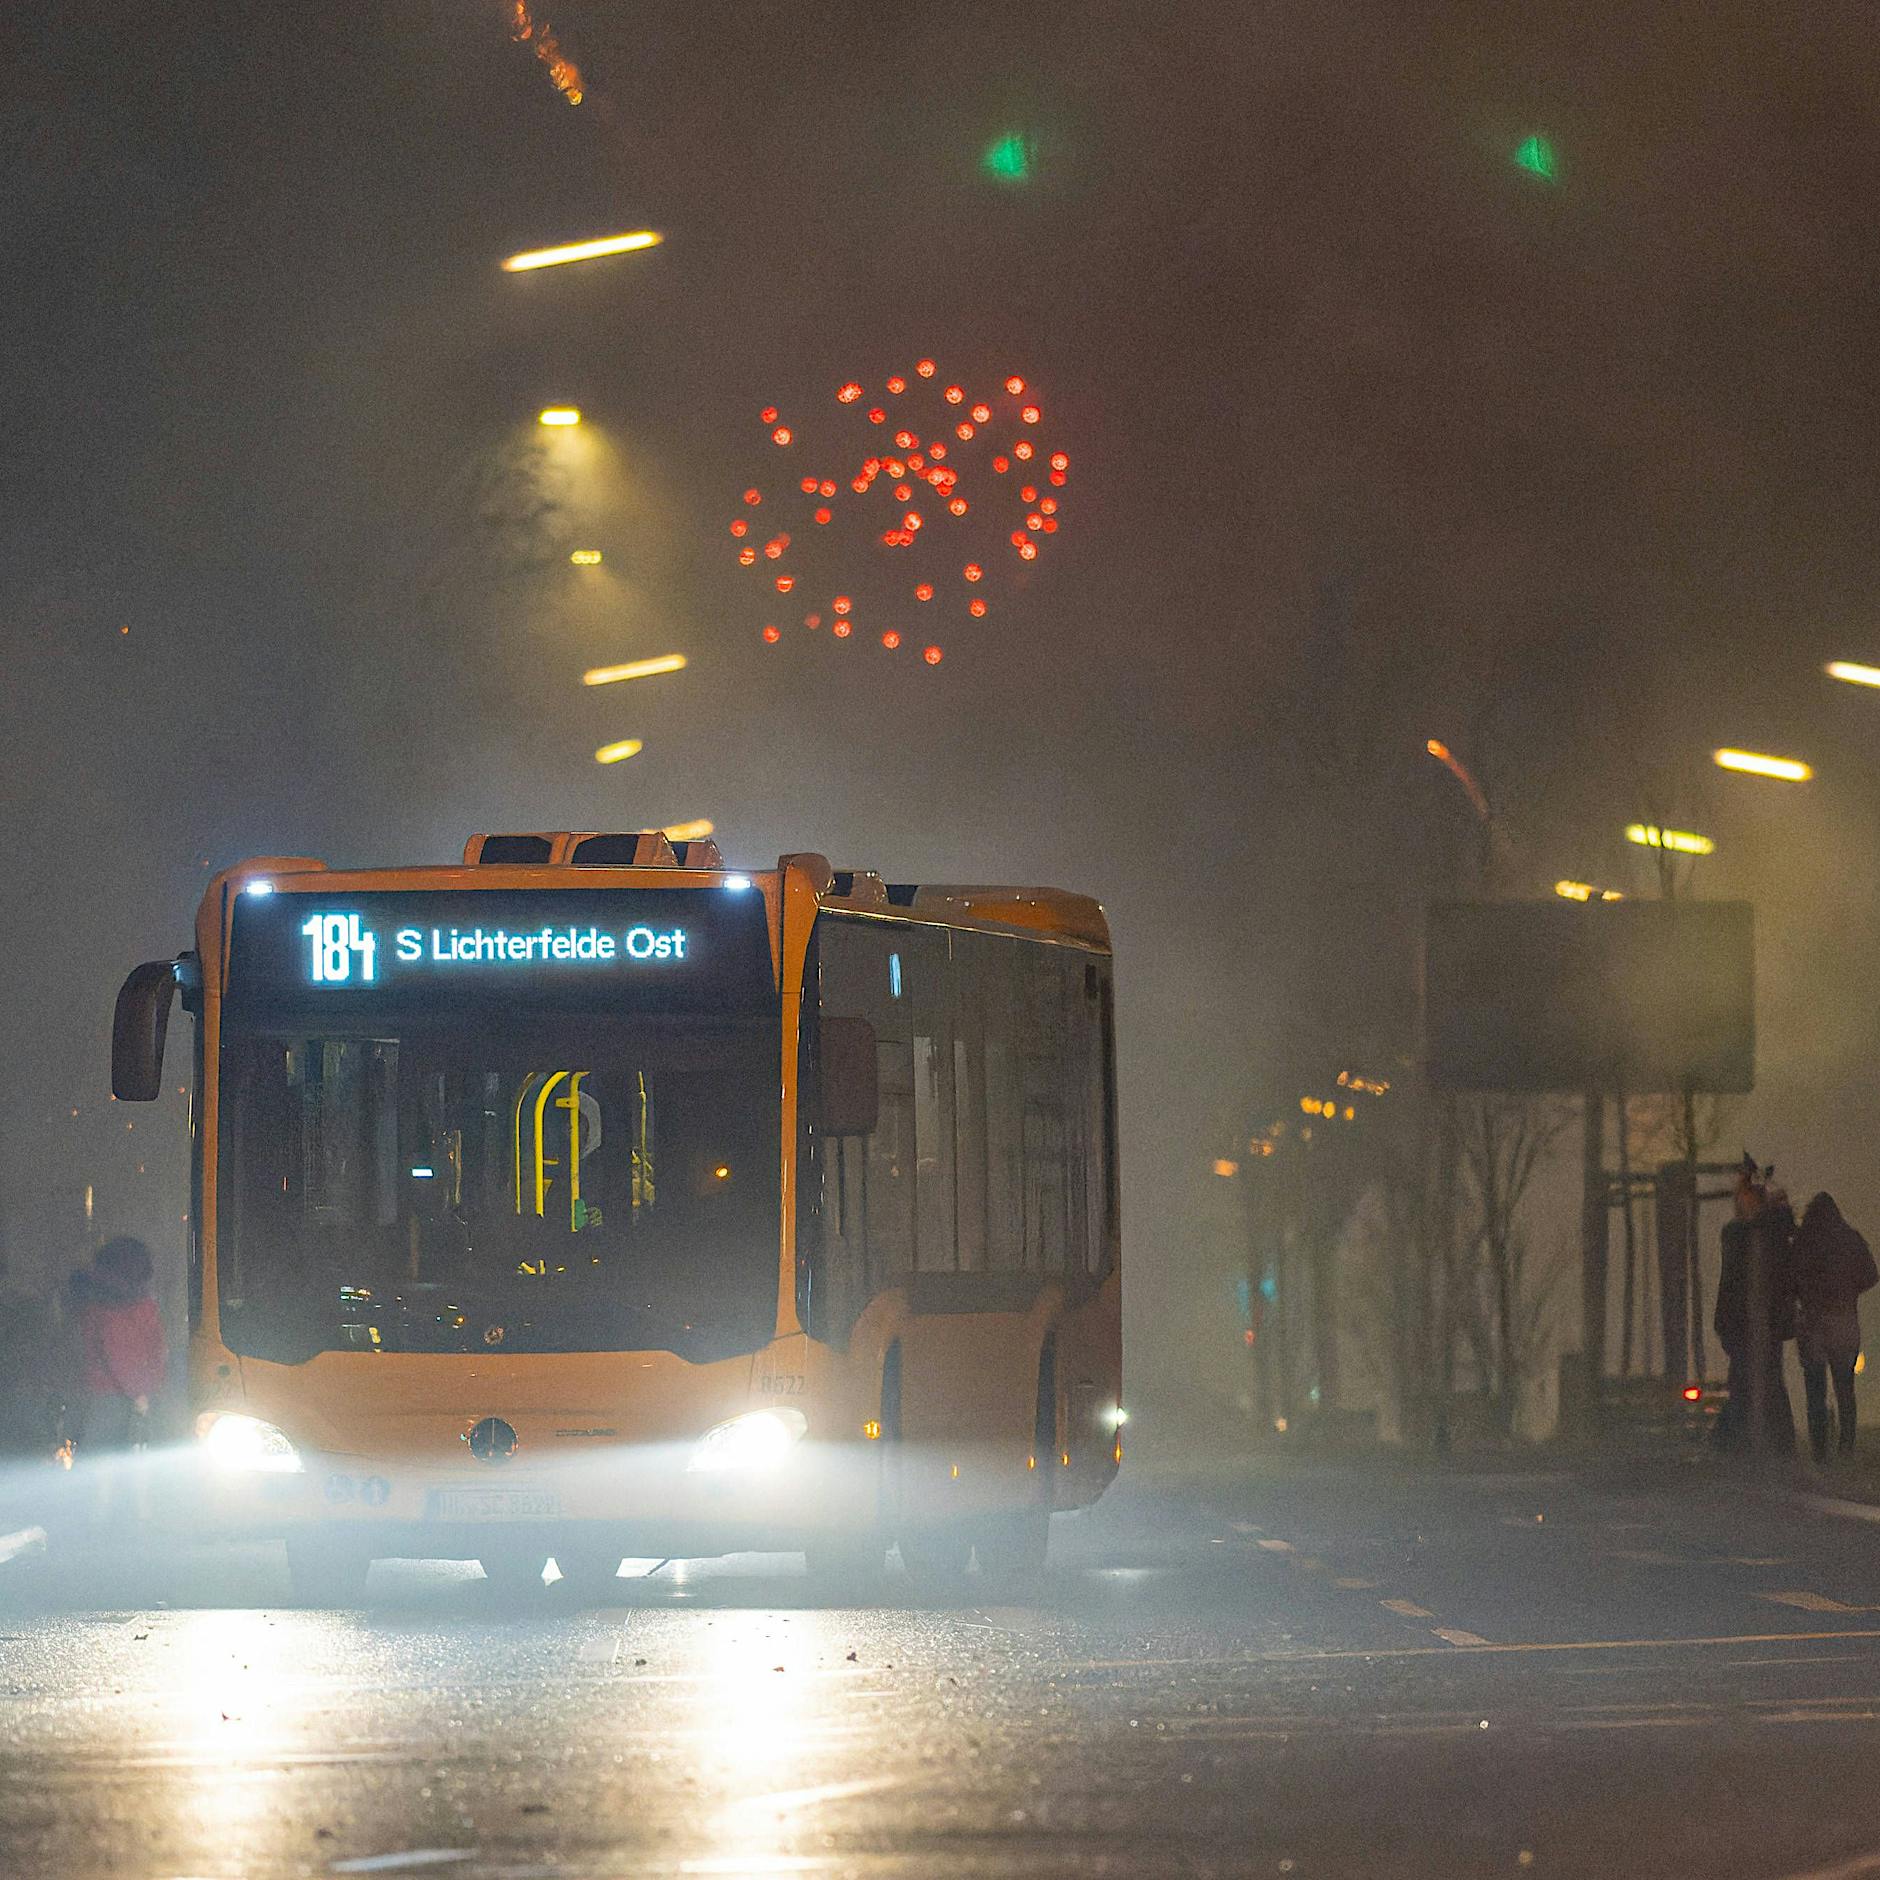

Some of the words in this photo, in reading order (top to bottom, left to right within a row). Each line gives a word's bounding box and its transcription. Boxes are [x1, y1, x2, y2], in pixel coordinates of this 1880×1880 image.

[302, 914, 376, 981] 184
[396, 928, 423, 961] S
[432, 928, 616, 961] Lichterfelde
[626, 927, 687, 959] Ost
